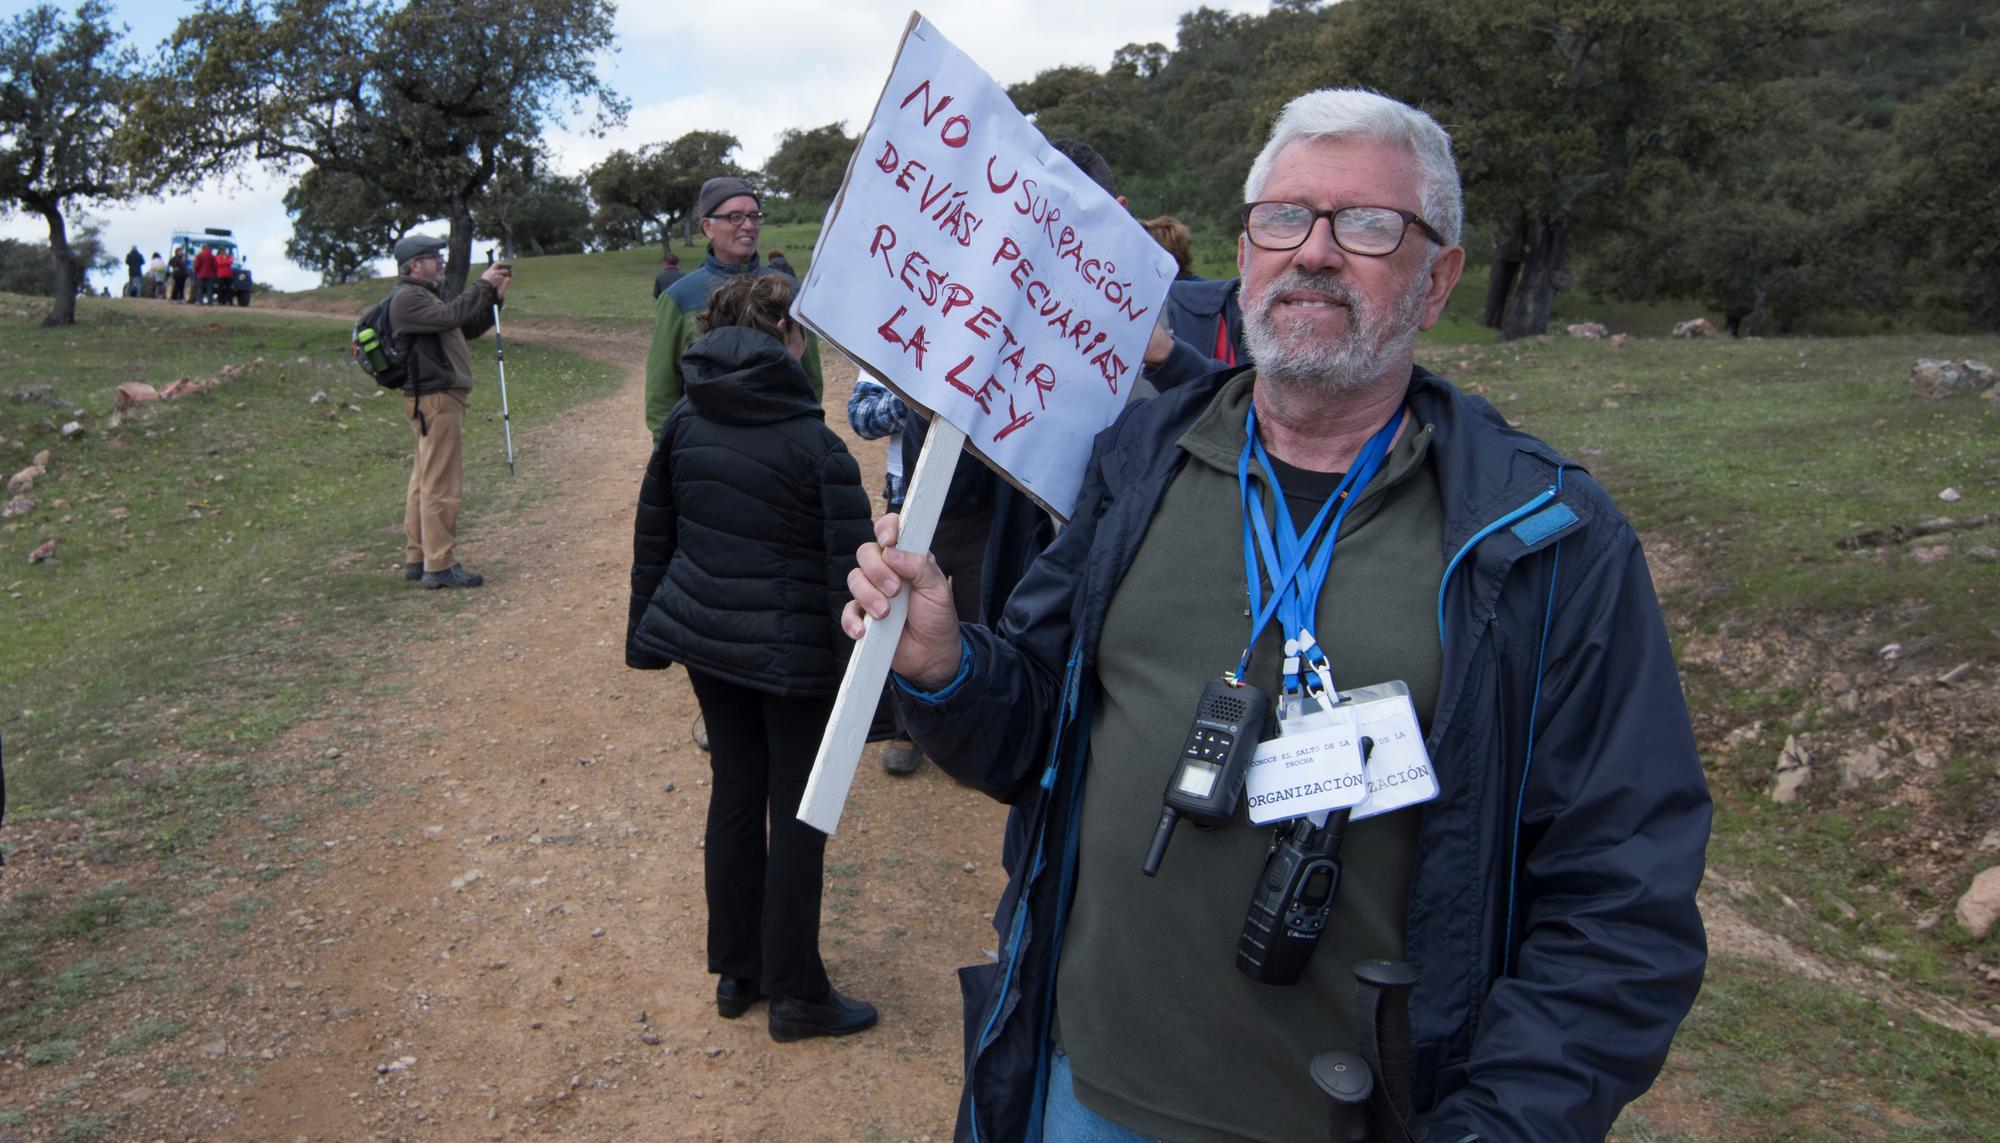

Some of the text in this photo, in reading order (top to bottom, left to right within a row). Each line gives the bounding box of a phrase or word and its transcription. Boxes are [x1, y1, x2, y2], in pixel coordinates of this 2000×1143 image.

[900, 80, 971, 148] NO
[870, 224, 1056, 410] RESPETAR
[993, 237, 1129, 395] PECUARIAS
[878, 304, 1035, 442] LA LEY
[1249, 740, 1351, 768] CONOCE EL SALTO DE LA
[1285, 757, 1314, 769] TROCHA
[1378, 731, 1407, 745] DE LA
[1248, 772, 1364, 808] ORGANIZACIÓN
